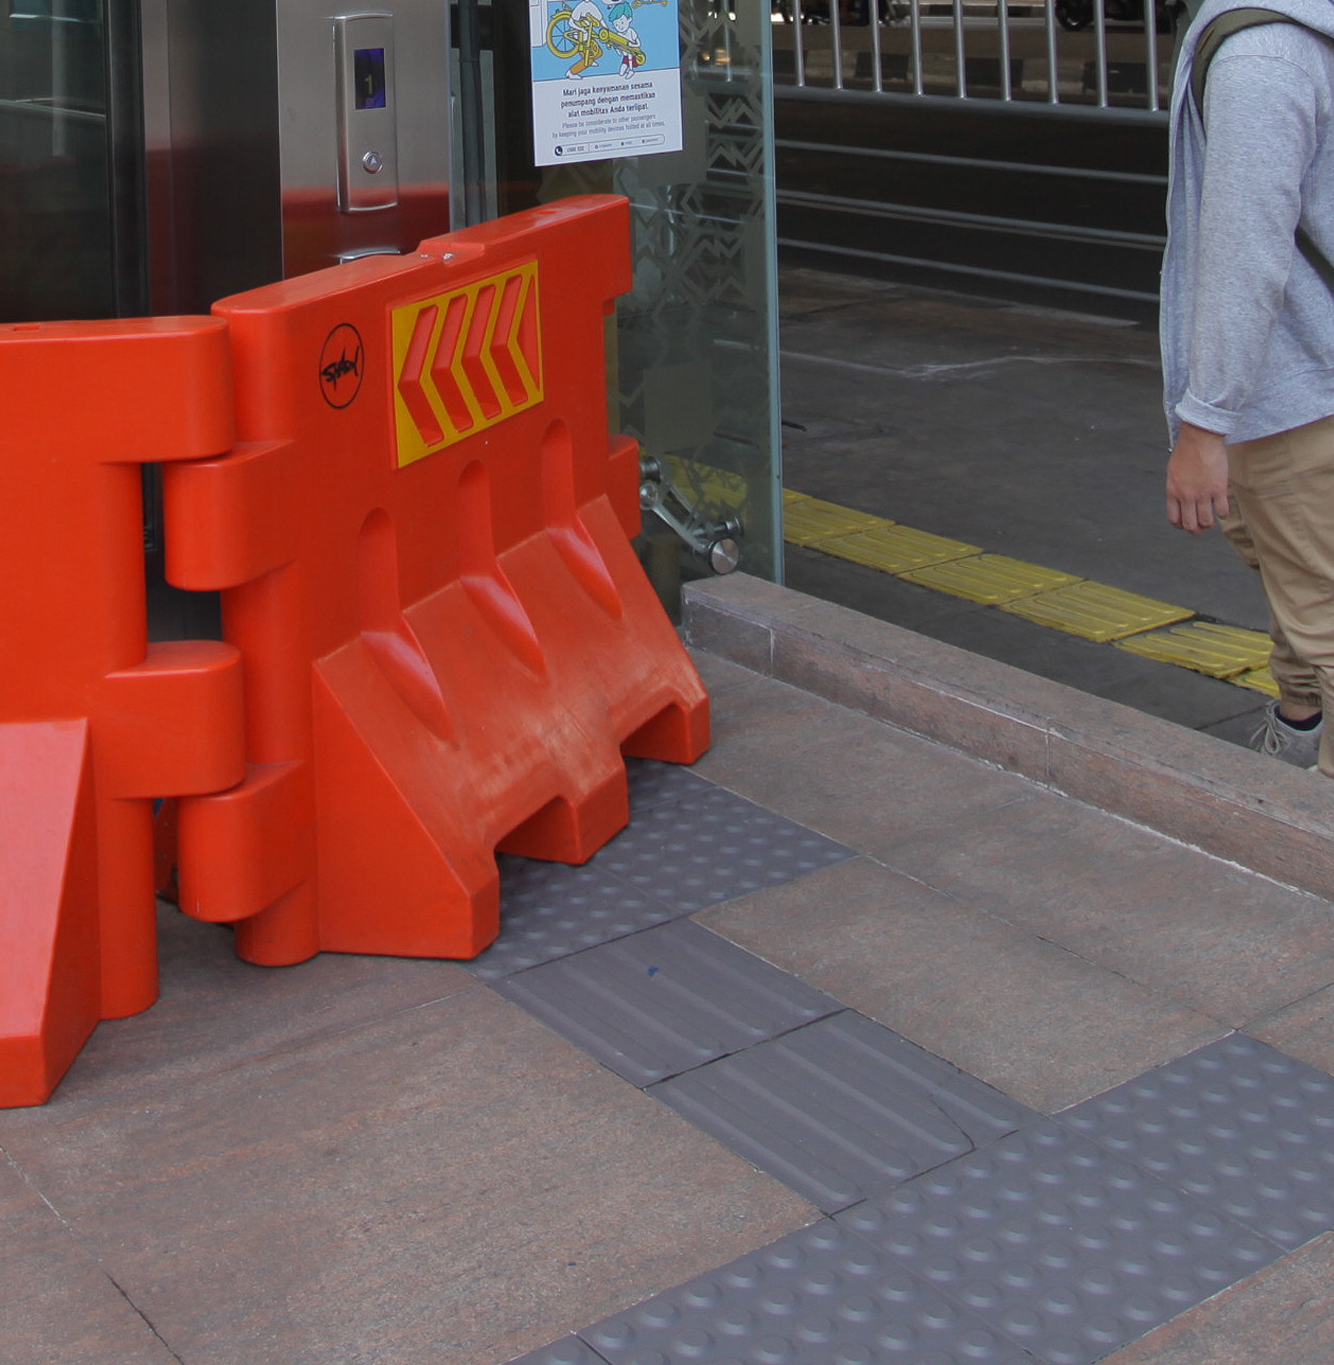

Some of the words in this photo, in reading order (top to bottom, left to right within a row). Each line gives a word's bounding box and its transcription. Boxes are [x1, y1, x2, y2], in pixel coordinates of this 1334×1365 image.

[563, 88, 577, 96] Mari
[578, 87, 591, 97] jaga
[592, 84, 630, 95] kenyamanan
[630, 81, 653, 90] sesama
[561, 98, 596, 109] penumpang
[597, 95, 619, 105] dengan
[620, 91, 656, 101] memastikan
[568, 110, 580, 118] alat
[580, 107, 609, 116] mobilitas
[610, 105, 625, 113] Anda
